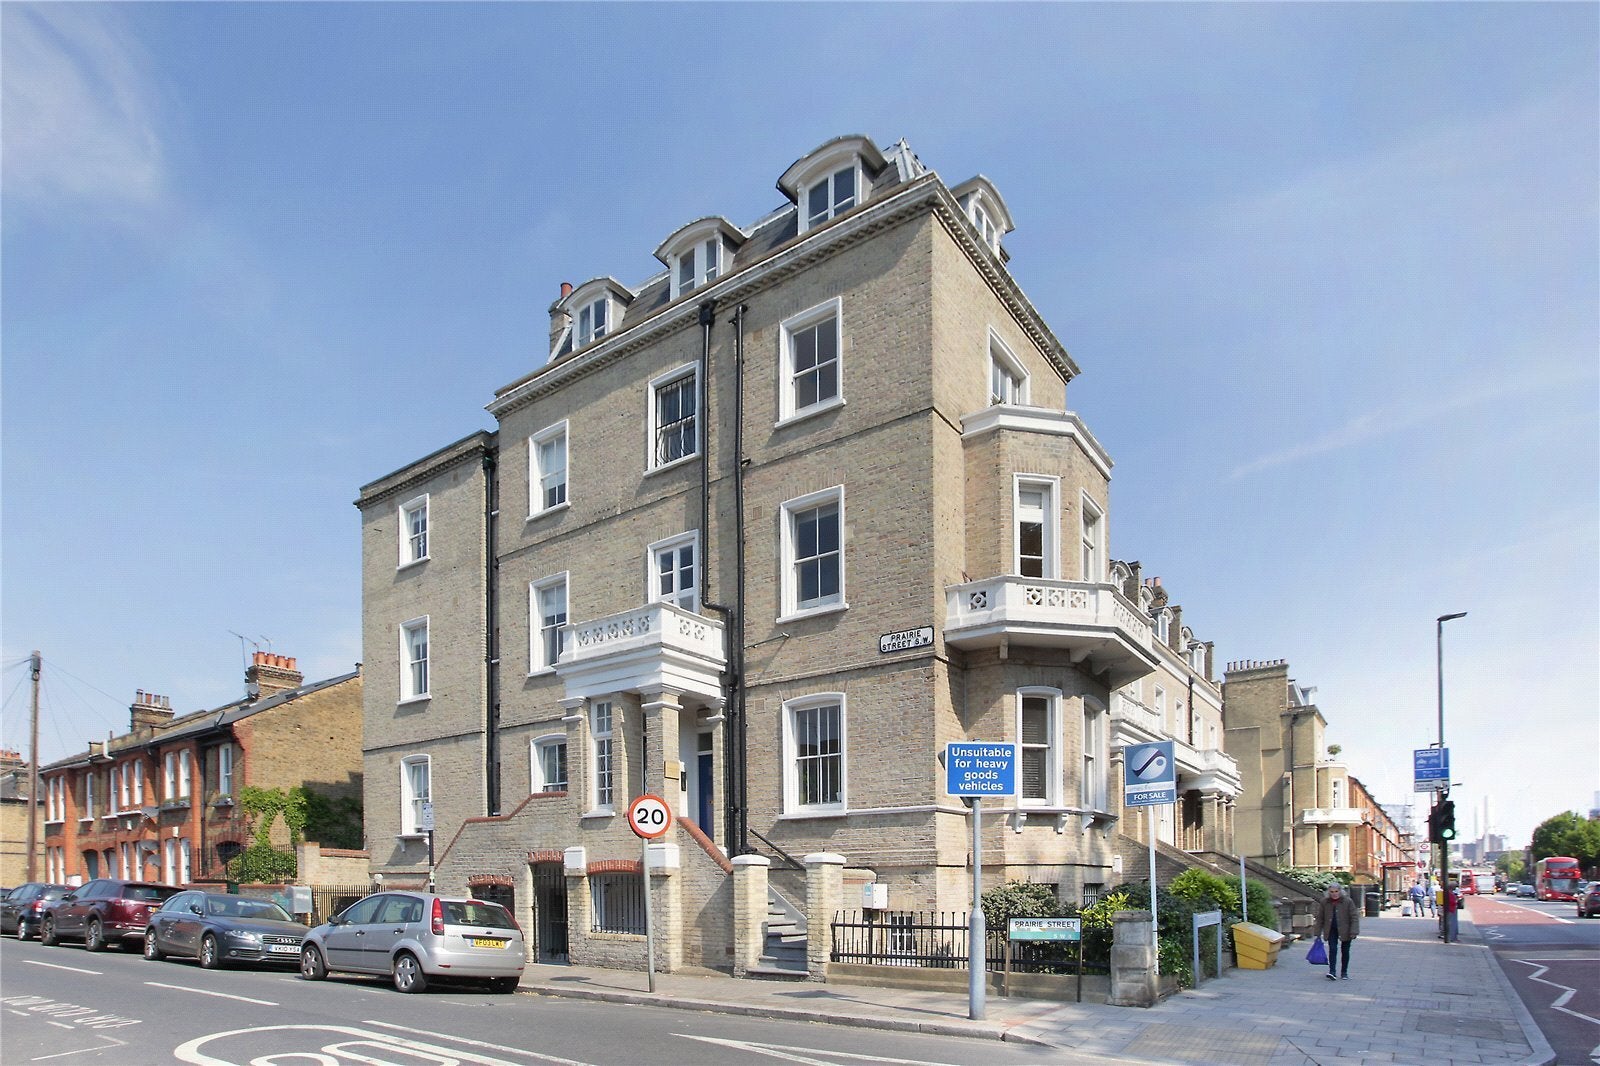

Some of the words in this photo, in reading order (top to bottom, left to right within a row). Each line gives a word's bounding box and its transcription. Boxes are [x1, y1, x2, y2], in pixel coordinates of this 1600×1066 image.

[890, 630, 921, 641] PRAIRIE
[882, 640, 911, 651] STREET
[951, 747, 1012, 757] Unsuitable
[954, 759, 972, 768] for
[976, 759, 1008, 770] heavy
[964, 770, 998, 781] goods
[958, 781, 1004, 791] vehicles
[1148, 791, 1167, 799] SALE
[636, 807, 664, 825] 20
[1014, 920, 1043, 928] PRAIRIE
[1047, 920, 1076, 928] STREET
